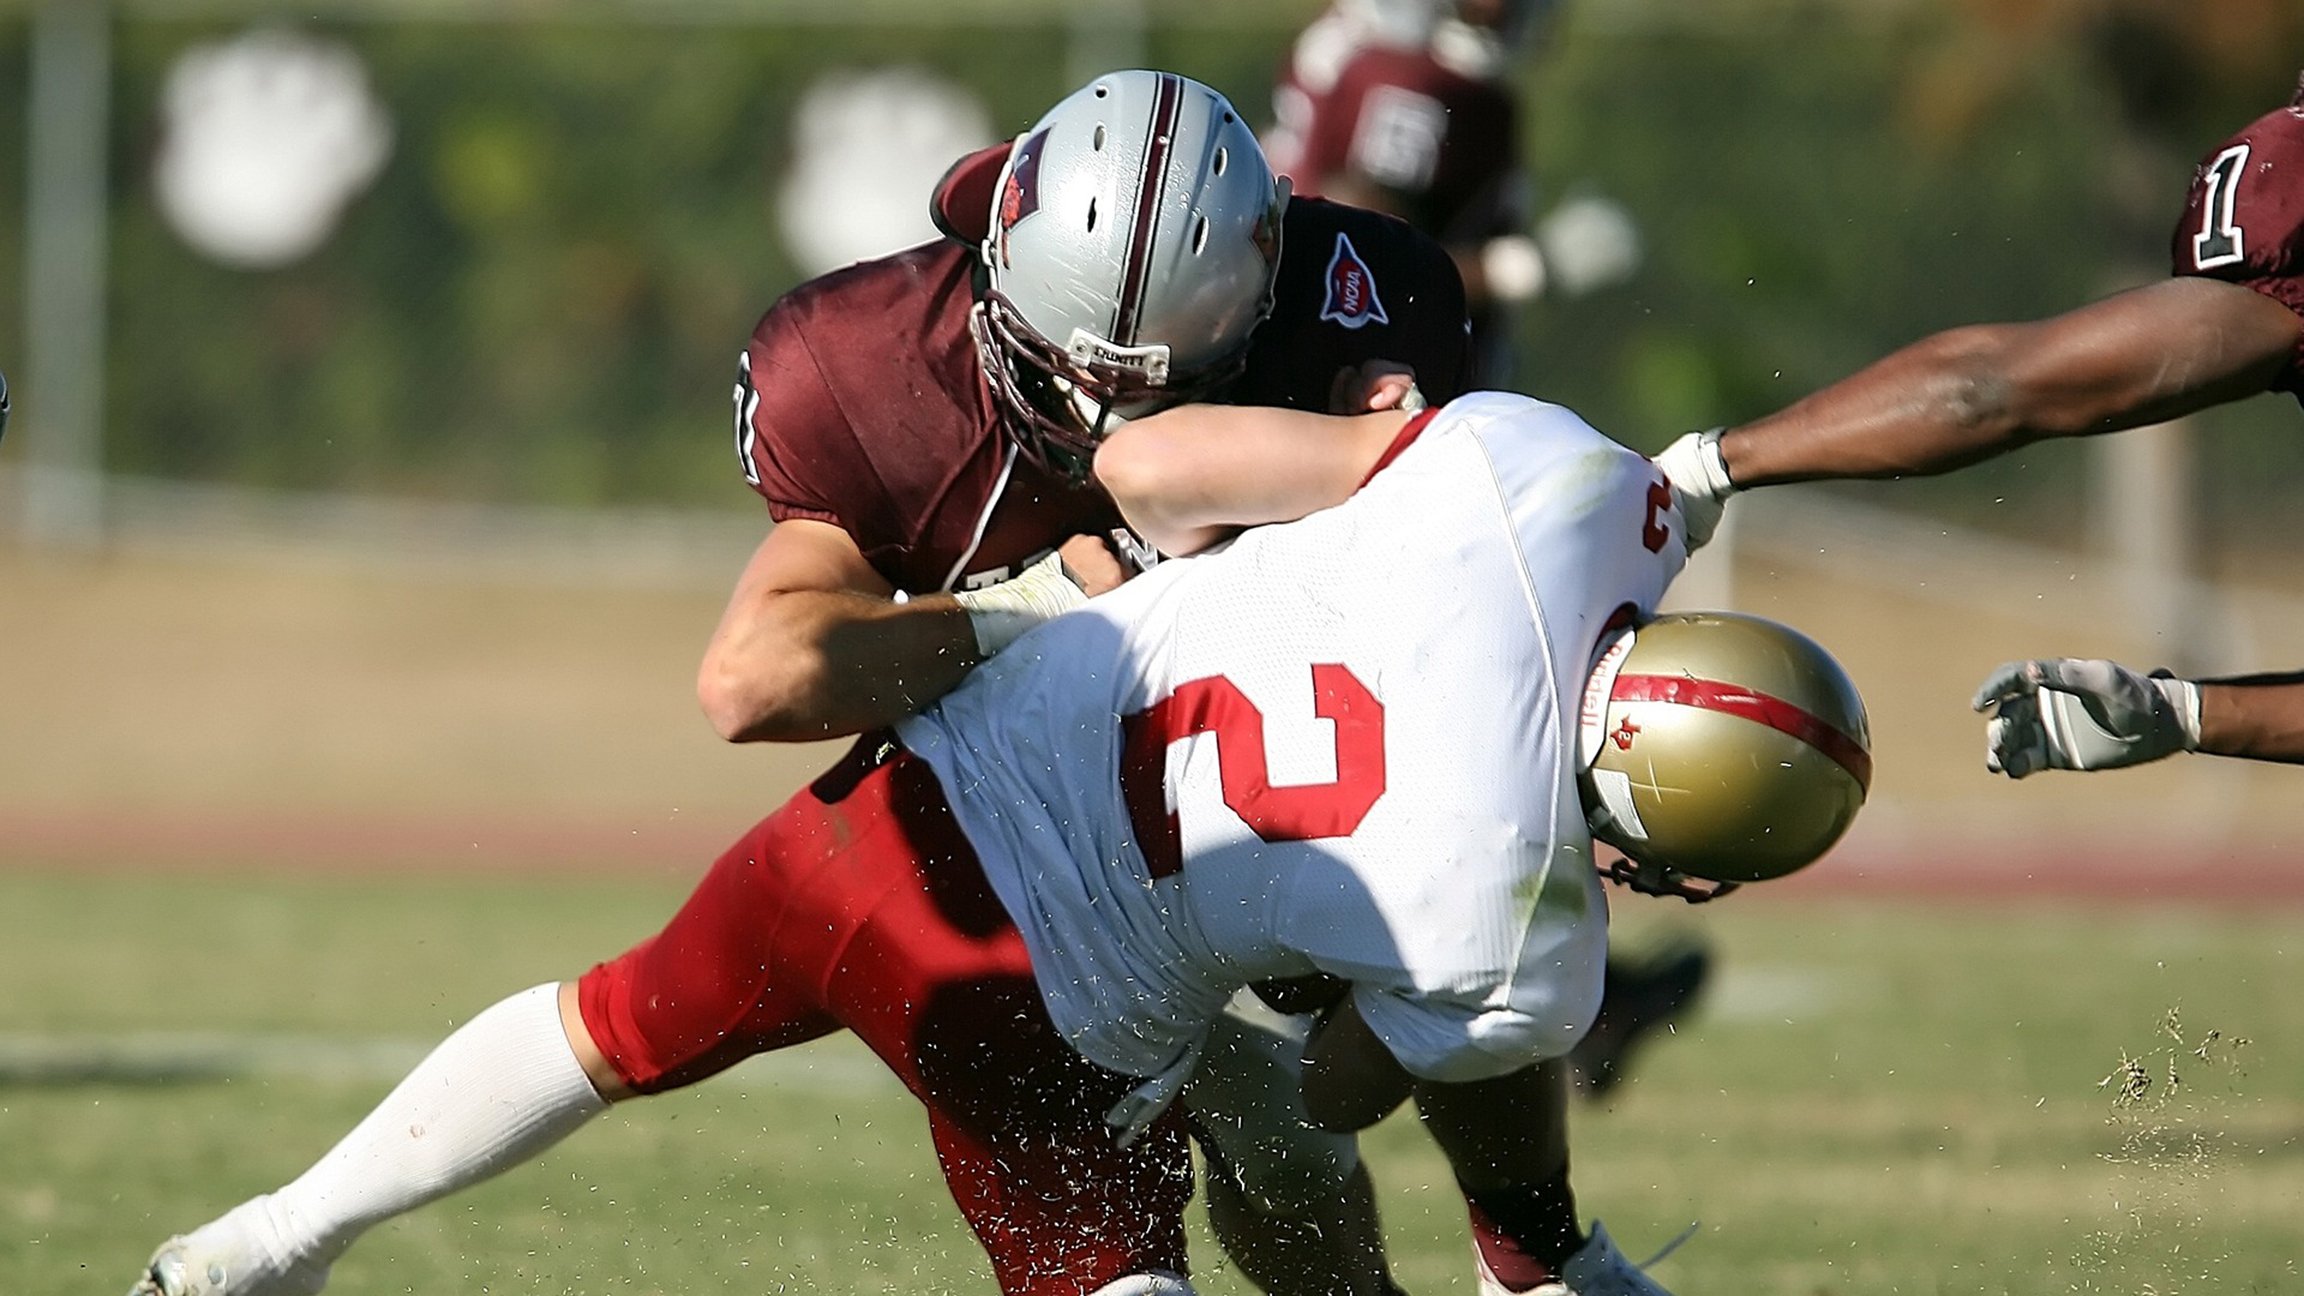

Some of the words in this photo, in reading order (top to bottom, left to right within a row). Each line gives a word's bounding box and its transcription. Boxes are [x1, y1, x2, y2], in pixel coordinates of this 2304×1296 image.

[2193, 144, 2251, 270] 1
[1343, 270, 1362, 312] NCAA
[1119, 663, 1386, 881] 2
[1619, 731, 1631, 741] 2
